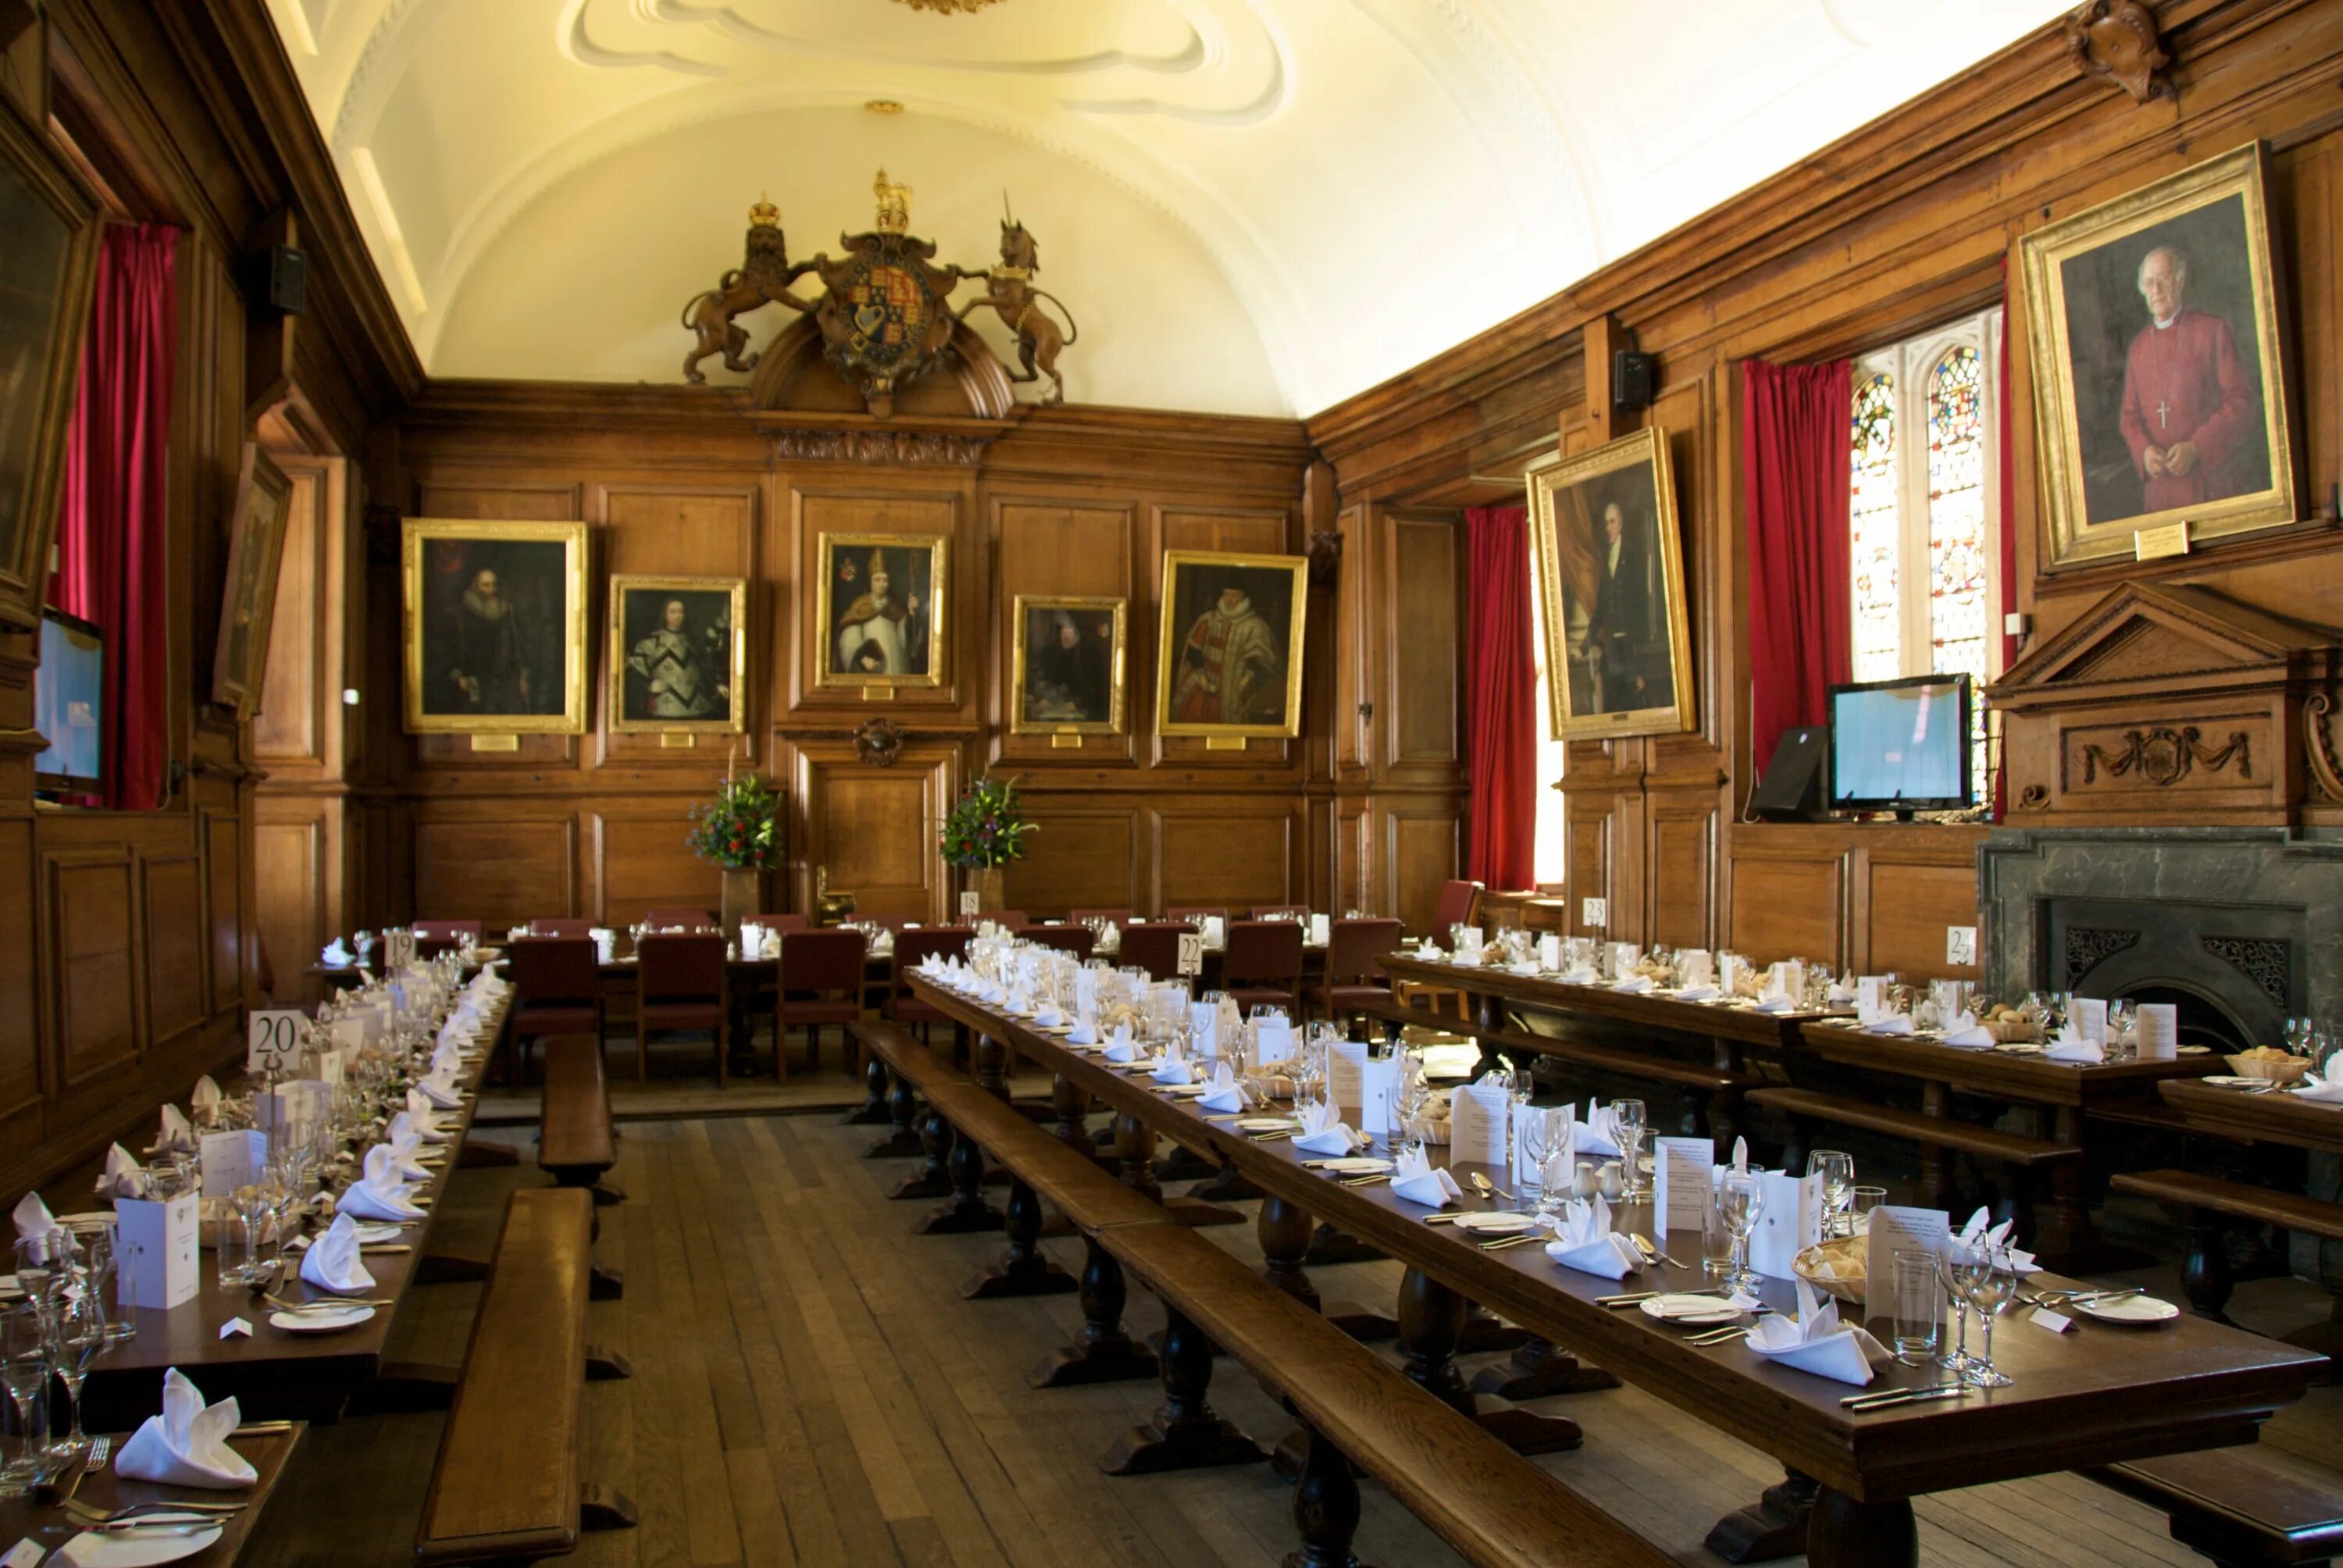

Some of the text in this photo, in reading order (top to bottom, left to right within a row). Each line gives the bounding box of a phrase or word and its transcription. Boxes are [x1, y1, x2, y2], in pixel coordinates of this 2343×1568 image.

[1587, 900, 1603, 919] 23
[393, 935, 412, 957] 19
[1182, 938, 1199, 963] 22
[1951, 931, 1971, 954] 24
[255, 1016, 295, 1053] 20
